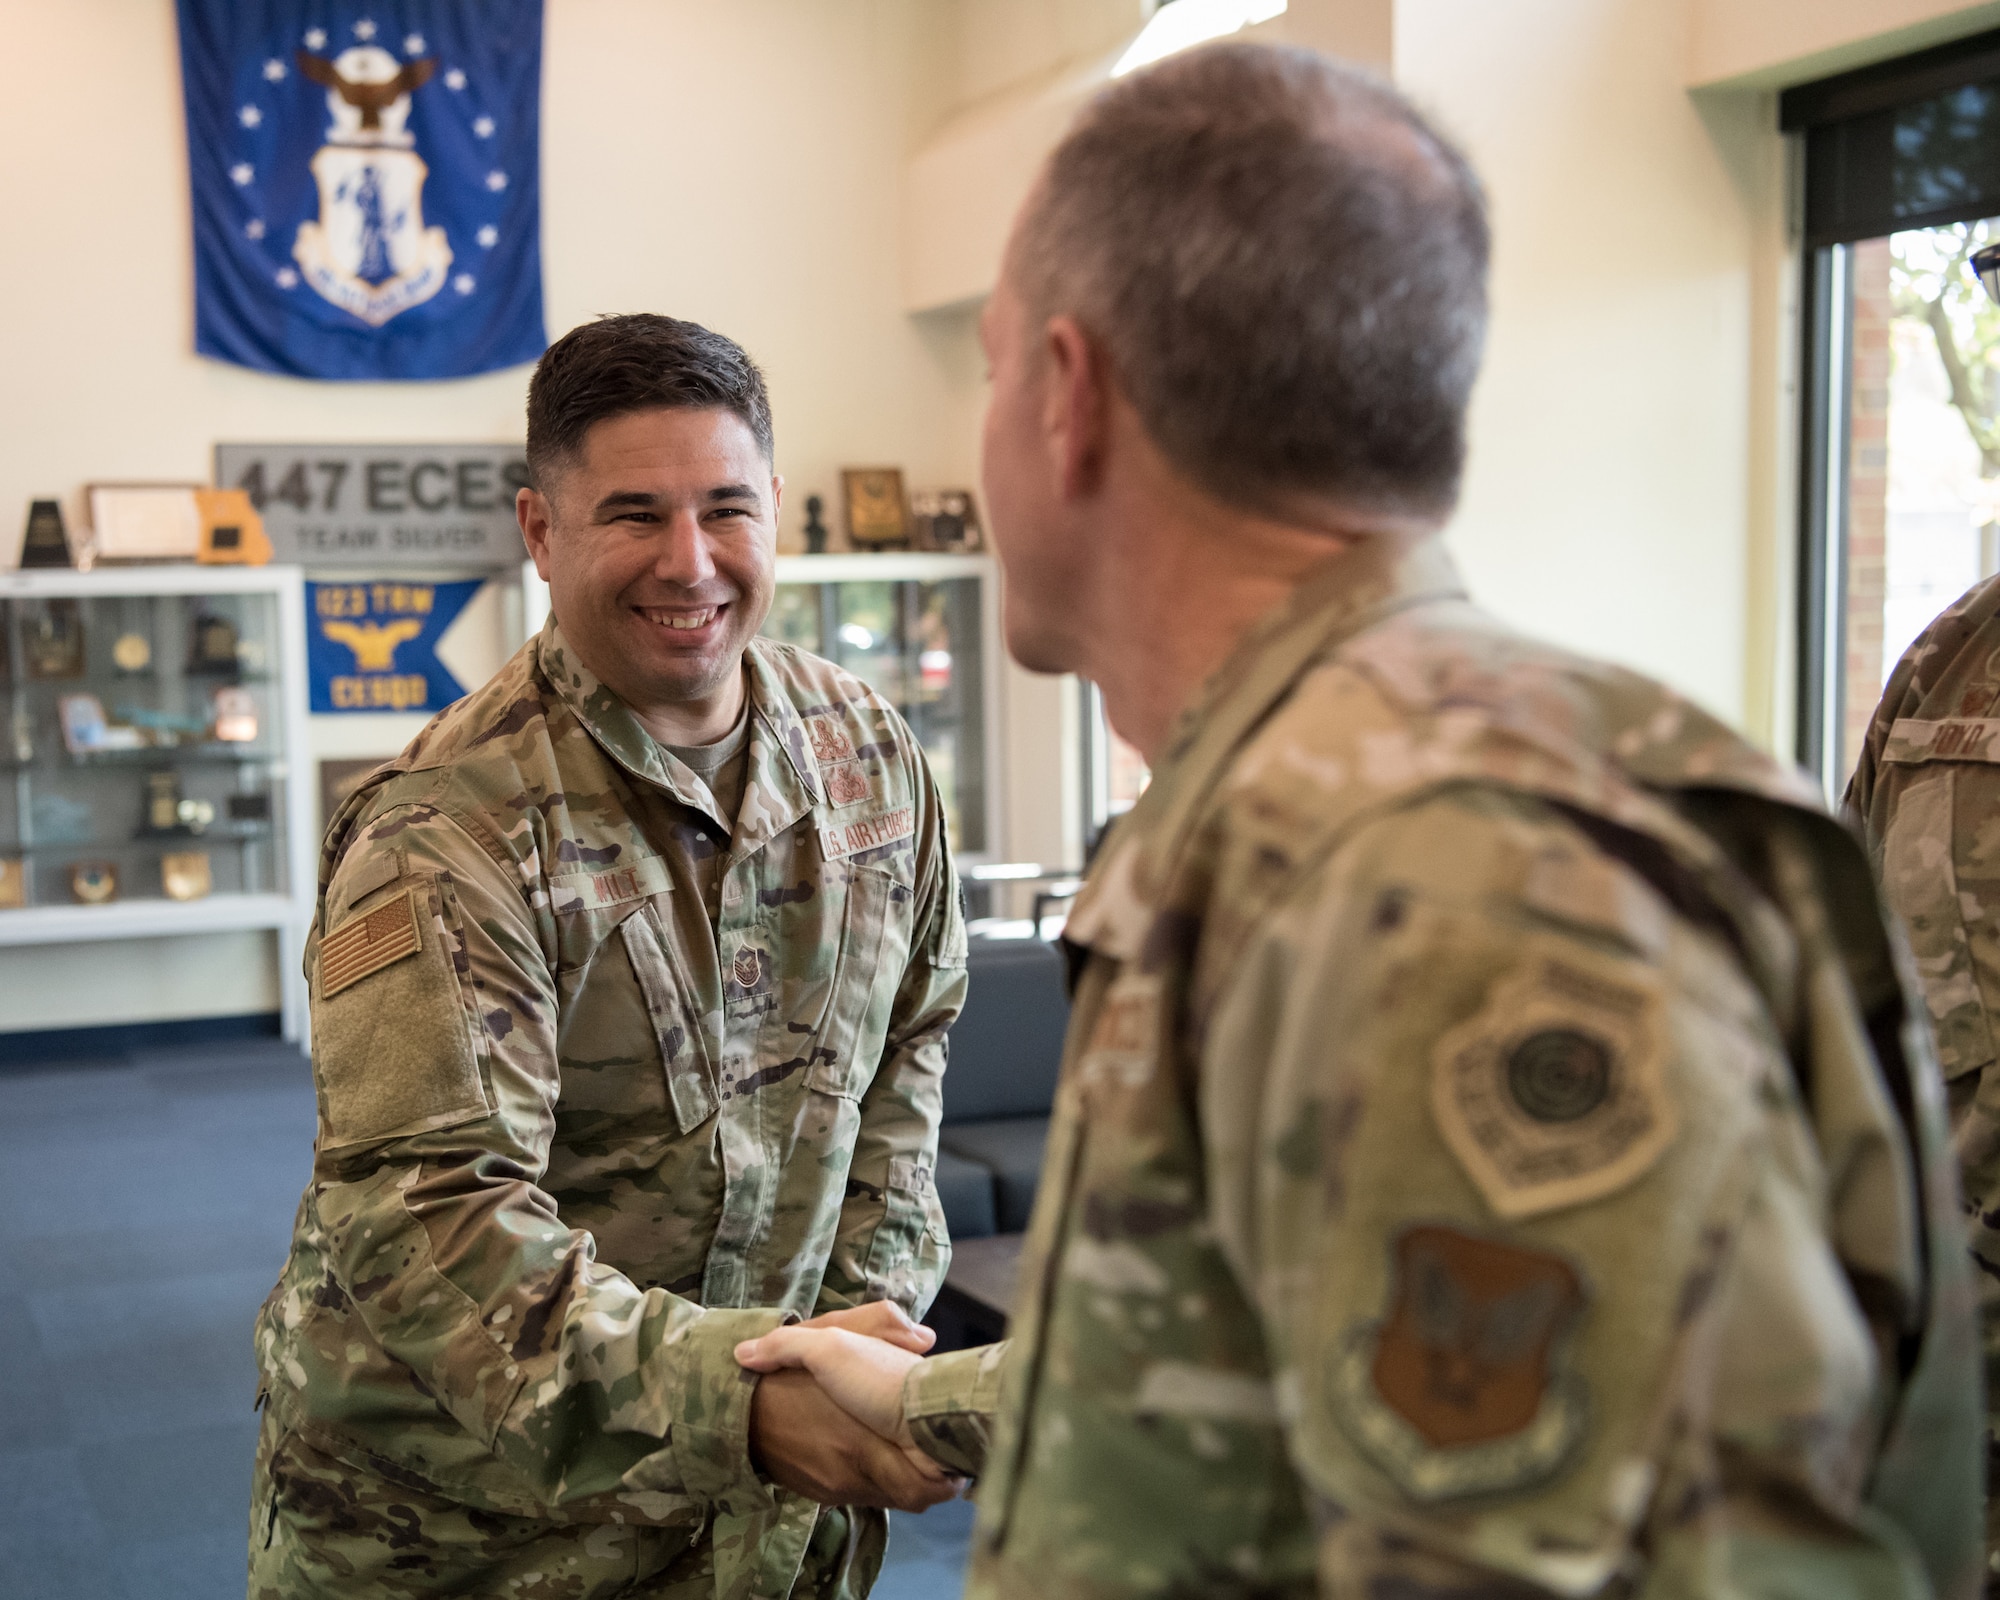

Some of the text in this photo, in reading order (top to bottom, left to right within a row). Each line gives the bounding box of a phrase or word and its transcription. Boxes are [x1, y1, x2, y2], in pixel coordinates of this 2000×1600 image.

[236, 459, 531, 514] 447 ECES
[296, 526, 487, 550] TEAM SILVER
[316, 585, 367, 617] 123
[823, 807, 913, 858] U.S. AIR FORCE
[591, 866, 640, 903] WILT
